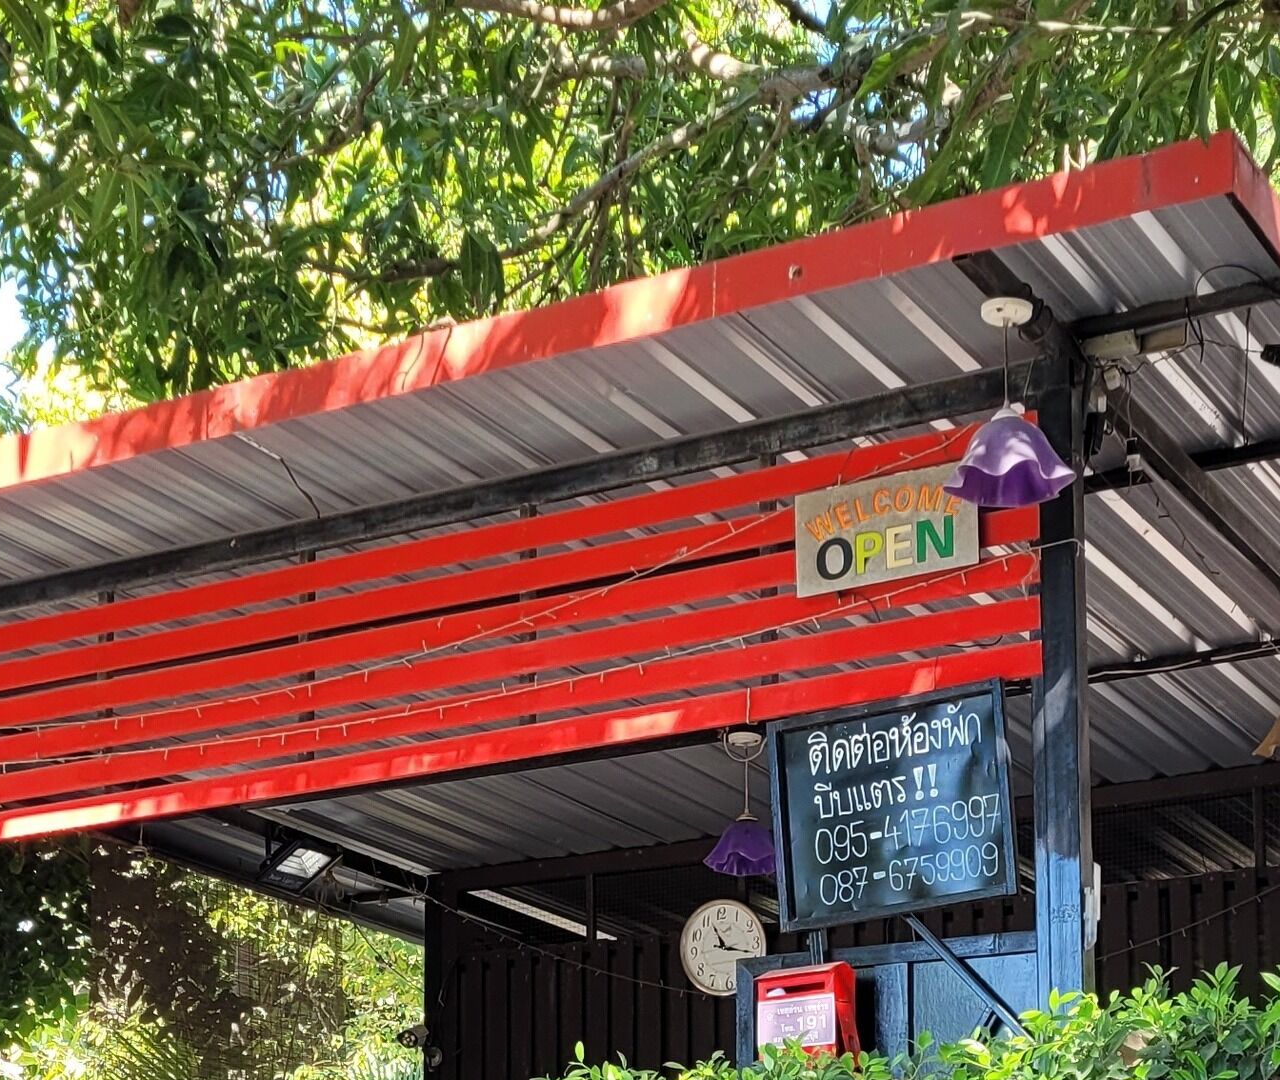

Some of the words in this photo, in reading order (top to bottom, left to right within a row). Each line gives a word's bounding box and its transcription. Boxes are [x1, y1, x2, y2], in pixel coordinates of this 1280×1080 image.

[805, 485, 962, 542] WELCOME
[816, 515, 954, 580] OPEN
[808, 702, 982, 776] ติดต่อห้องพัก
[815, 793, 1000, 865] 095-4176997
[820, 842, 999, 905] 087-6759909
[717, 906, 727, 921] 12
[702, 915, 710, 928] 11
[746, 919, 754, 933] 2
[692, 928, 702, 943] 10
[752, 936, 760, 950] 3
[690, 946, 698, 960] 9
[697, 962, 705, 976] 8
[709, 974, 716, 987] 7
[725, 976, 734, 991] 6
[796, 1014, 827, 1032] 191
